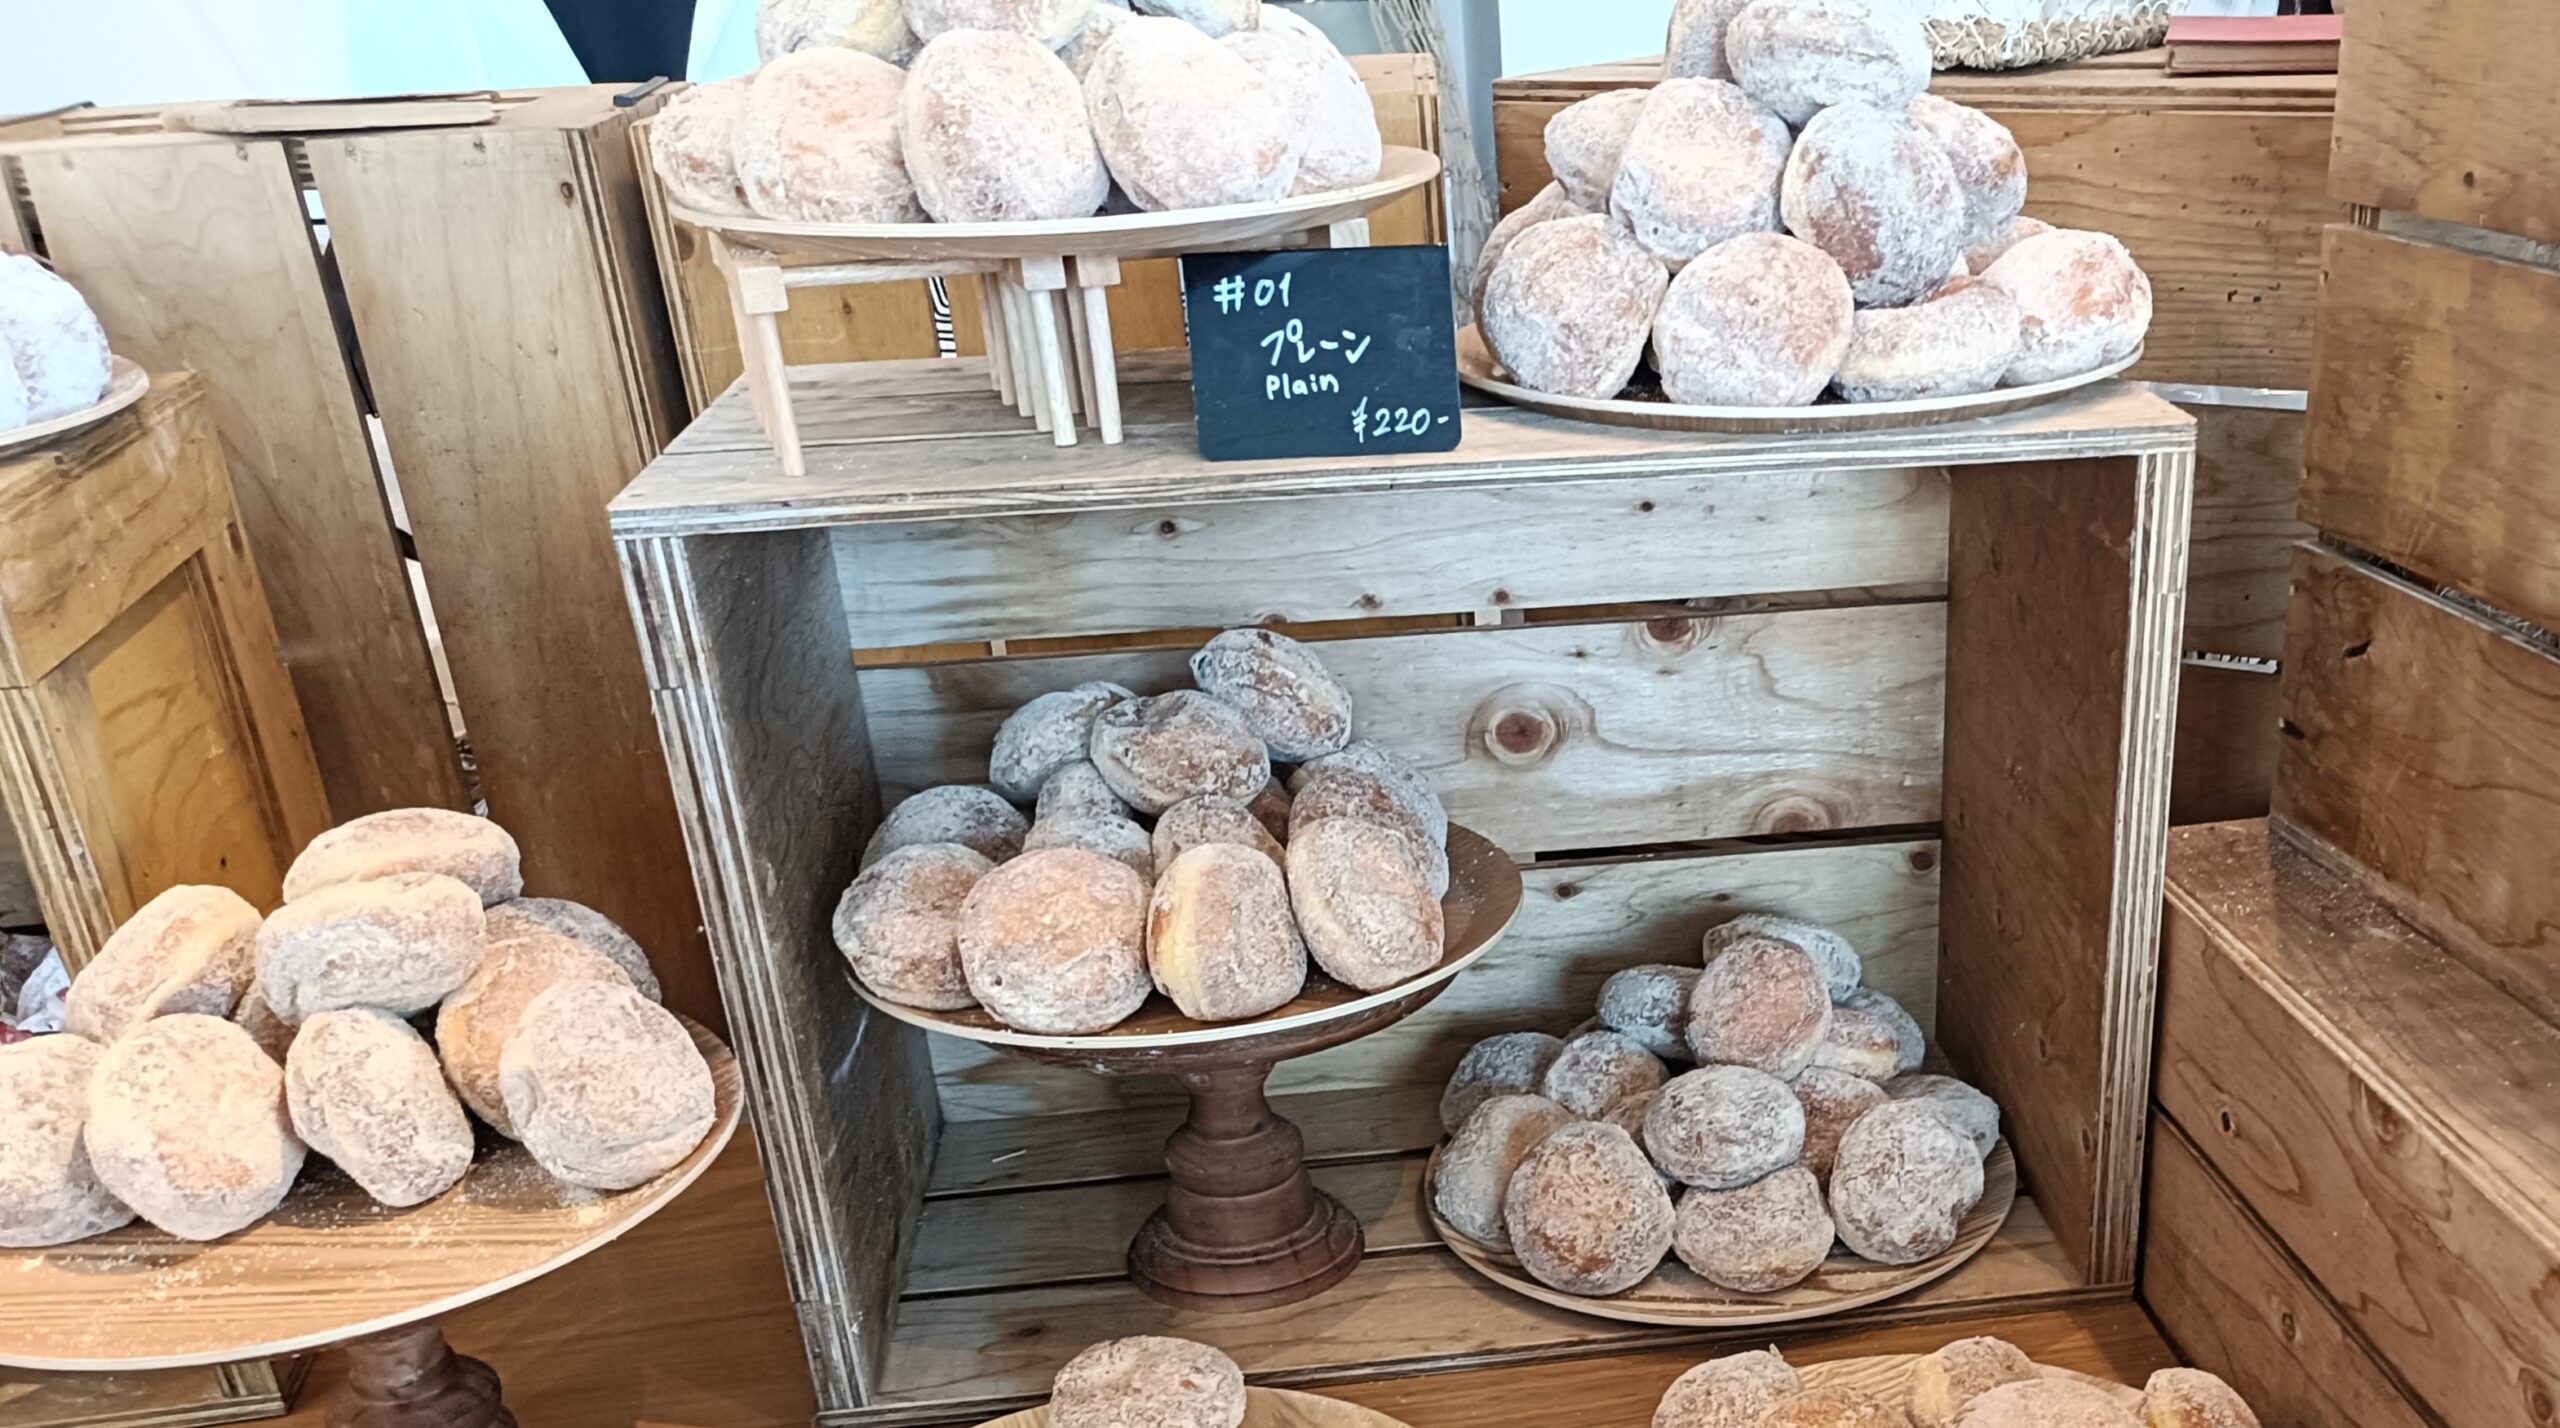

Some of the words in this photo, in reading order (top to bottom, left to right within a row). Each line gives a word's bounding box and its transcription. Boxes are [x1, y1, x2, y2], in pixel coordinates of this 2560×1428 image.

[1260, 318, 1371, 367] プレーン
[1265, 372, 1340, 401] Plain
